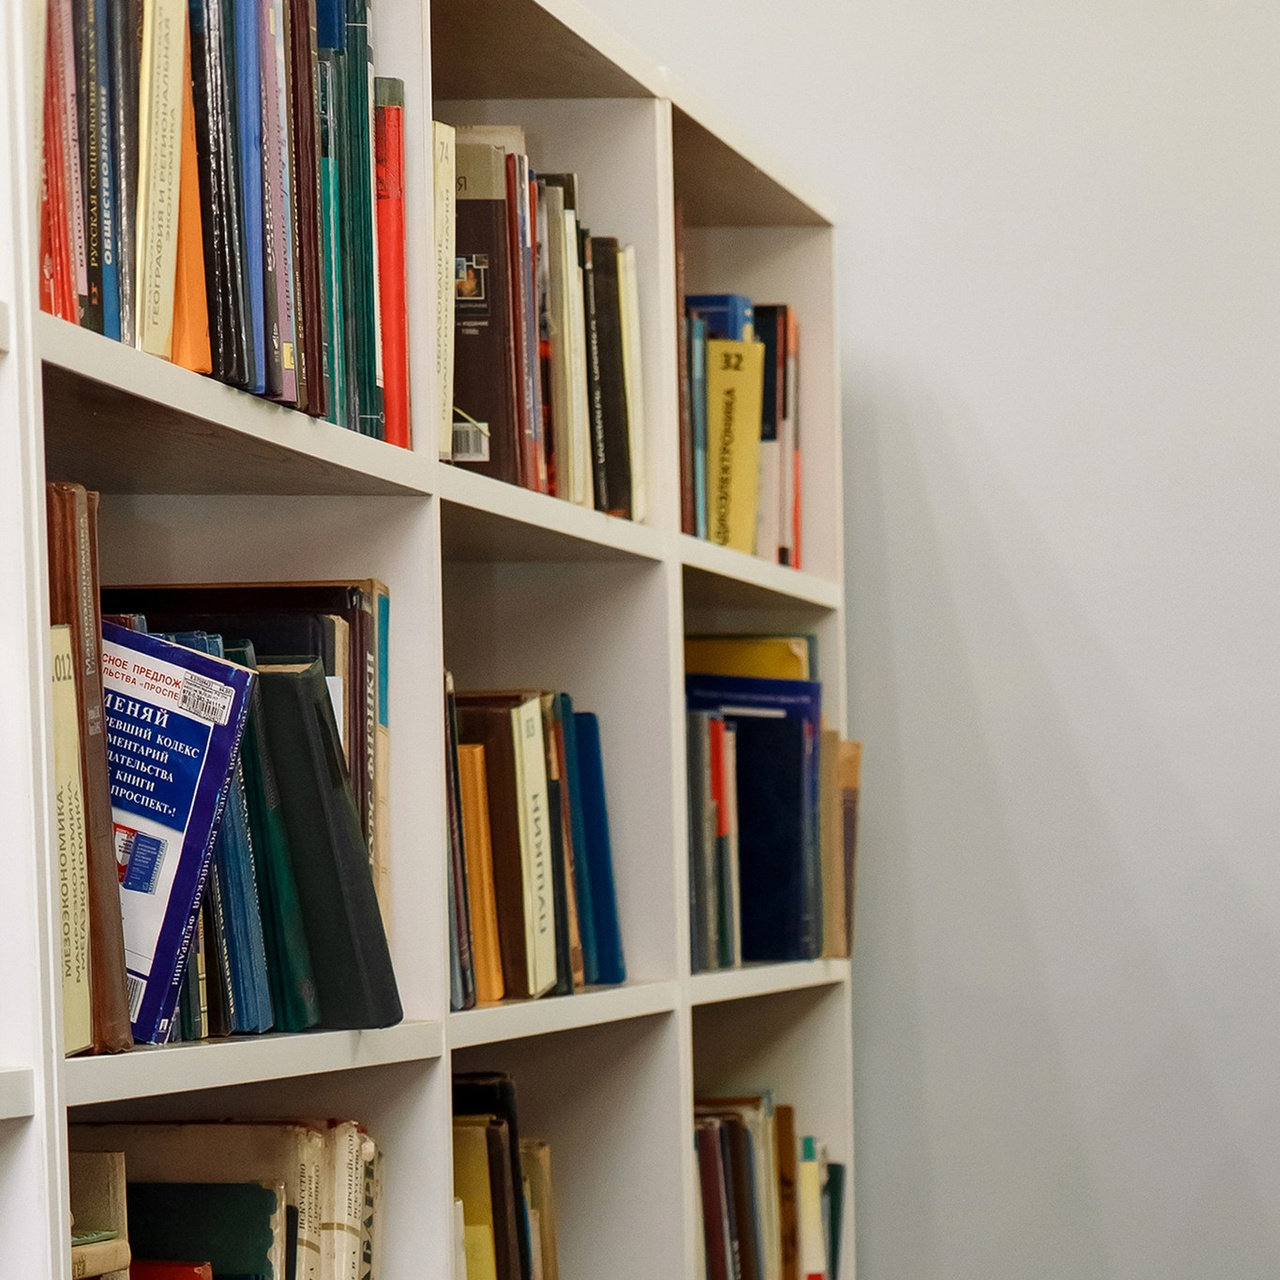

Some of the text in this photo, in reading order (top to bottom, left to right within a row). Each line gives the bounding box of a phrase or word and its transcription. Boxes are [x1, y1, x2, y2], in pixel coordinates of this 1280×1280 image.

[88, 80, 98, 190] СОЦИОЛОГИЯ
[157, 17, 169, 182] РЕГИОНАЛЬНАЯ
[101, 84, 112, 265] ОБЩЕСТВОЗНАНИЕ
[88, 196, 99, 268] РУССКАЯ
[152, 206, 167, 326] ГЕОГРАФИЯ
[722, 353, 743, 371] 32
[77, 517, 96, 678] Макроэкономика
[132, 663, 182, 688] ПРЕДЛОЖ
[366, 650, 376, 781] ФИЗИКИ
[115, 768, 155, 793] КНИГИ
[155, 734, 200, 759] КОДЕКС
[214, 776, 232, 824] КОДЕКС
[57, 783, 72, 978] МЕЗОЭКОНОМИКА.
[68, 774, 81, 984] МАКРОЭКОНОМИКА.
[75, 783, 86, 971] МЕГАЭКОНОМИКА.
[191, 829, 219, 910] РОССИЙСКОЙ
[531, 793, 548, 935] ПУШКИН
[171, 914, 196, 987] ФЕДЕРАЦИИ
[298, 1162, 307, 1231] ИСКУССТВО
[346, 1130, 355, 1218] ЕВРОПЕЙСКОЕ
